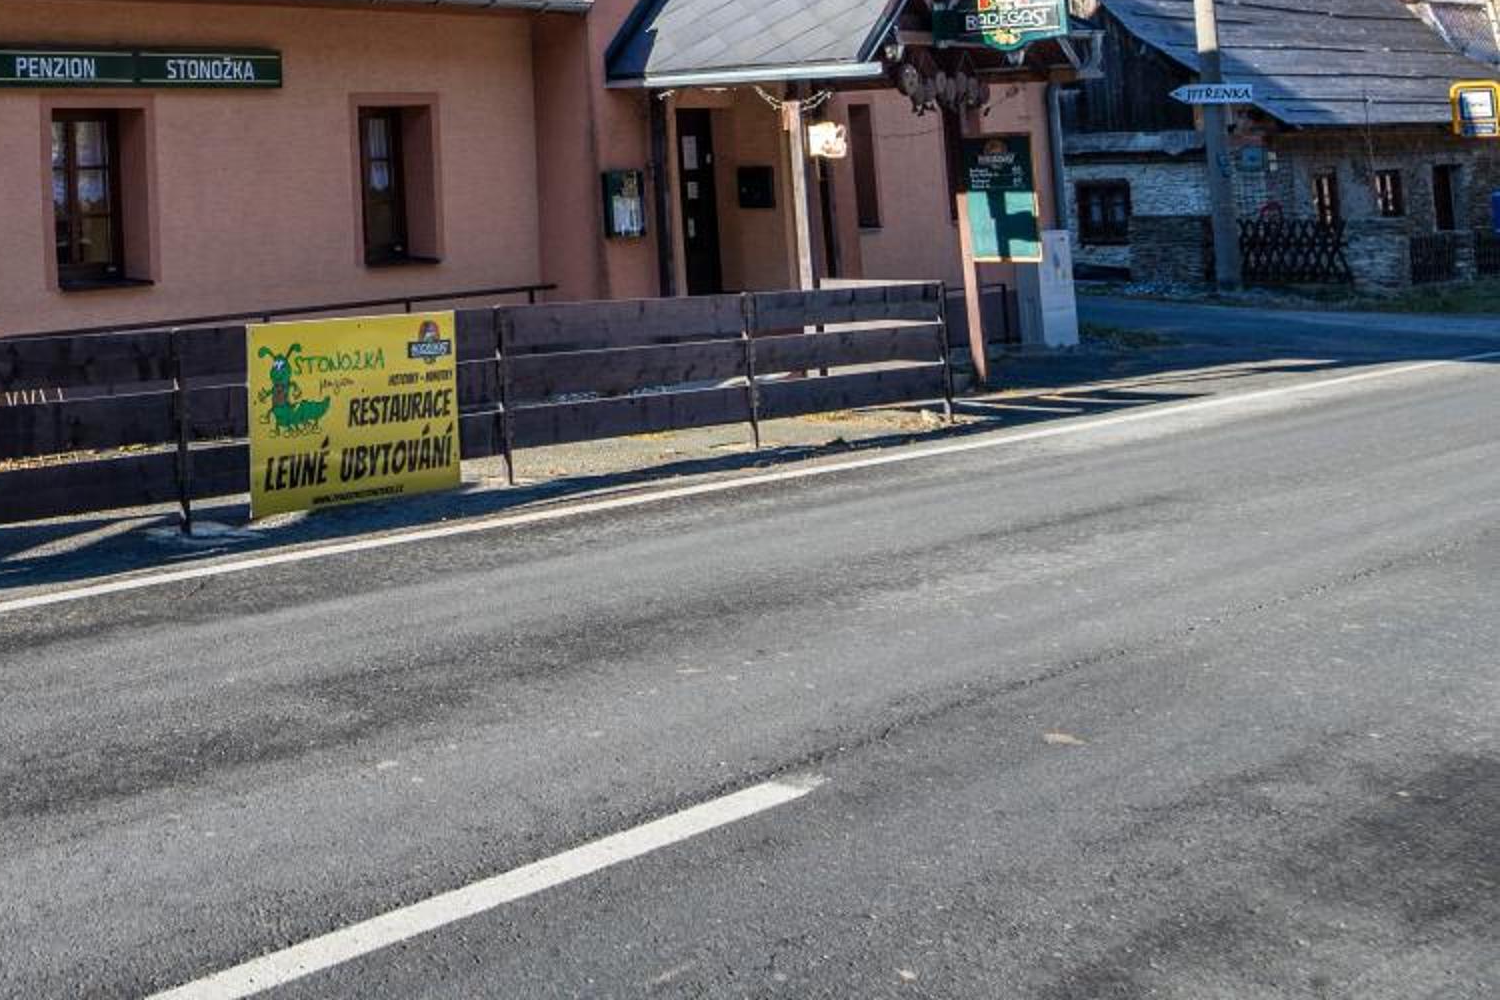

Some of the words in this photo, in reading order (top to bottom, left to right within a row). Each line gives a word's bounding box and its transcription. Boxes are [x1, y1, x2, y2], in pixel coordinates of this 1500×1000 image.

[965, 8, 1051, 30] RADEGAST
[15, 56, 96, 79] PENZION
[166, 56, 255, 82] STONOŽKA
[348, 388, 453, 427] RESTAURACE
[264, 437, 331, 492] LEVNÉ
[340, 423, 453, 483] UBYTOVÁNÍ
